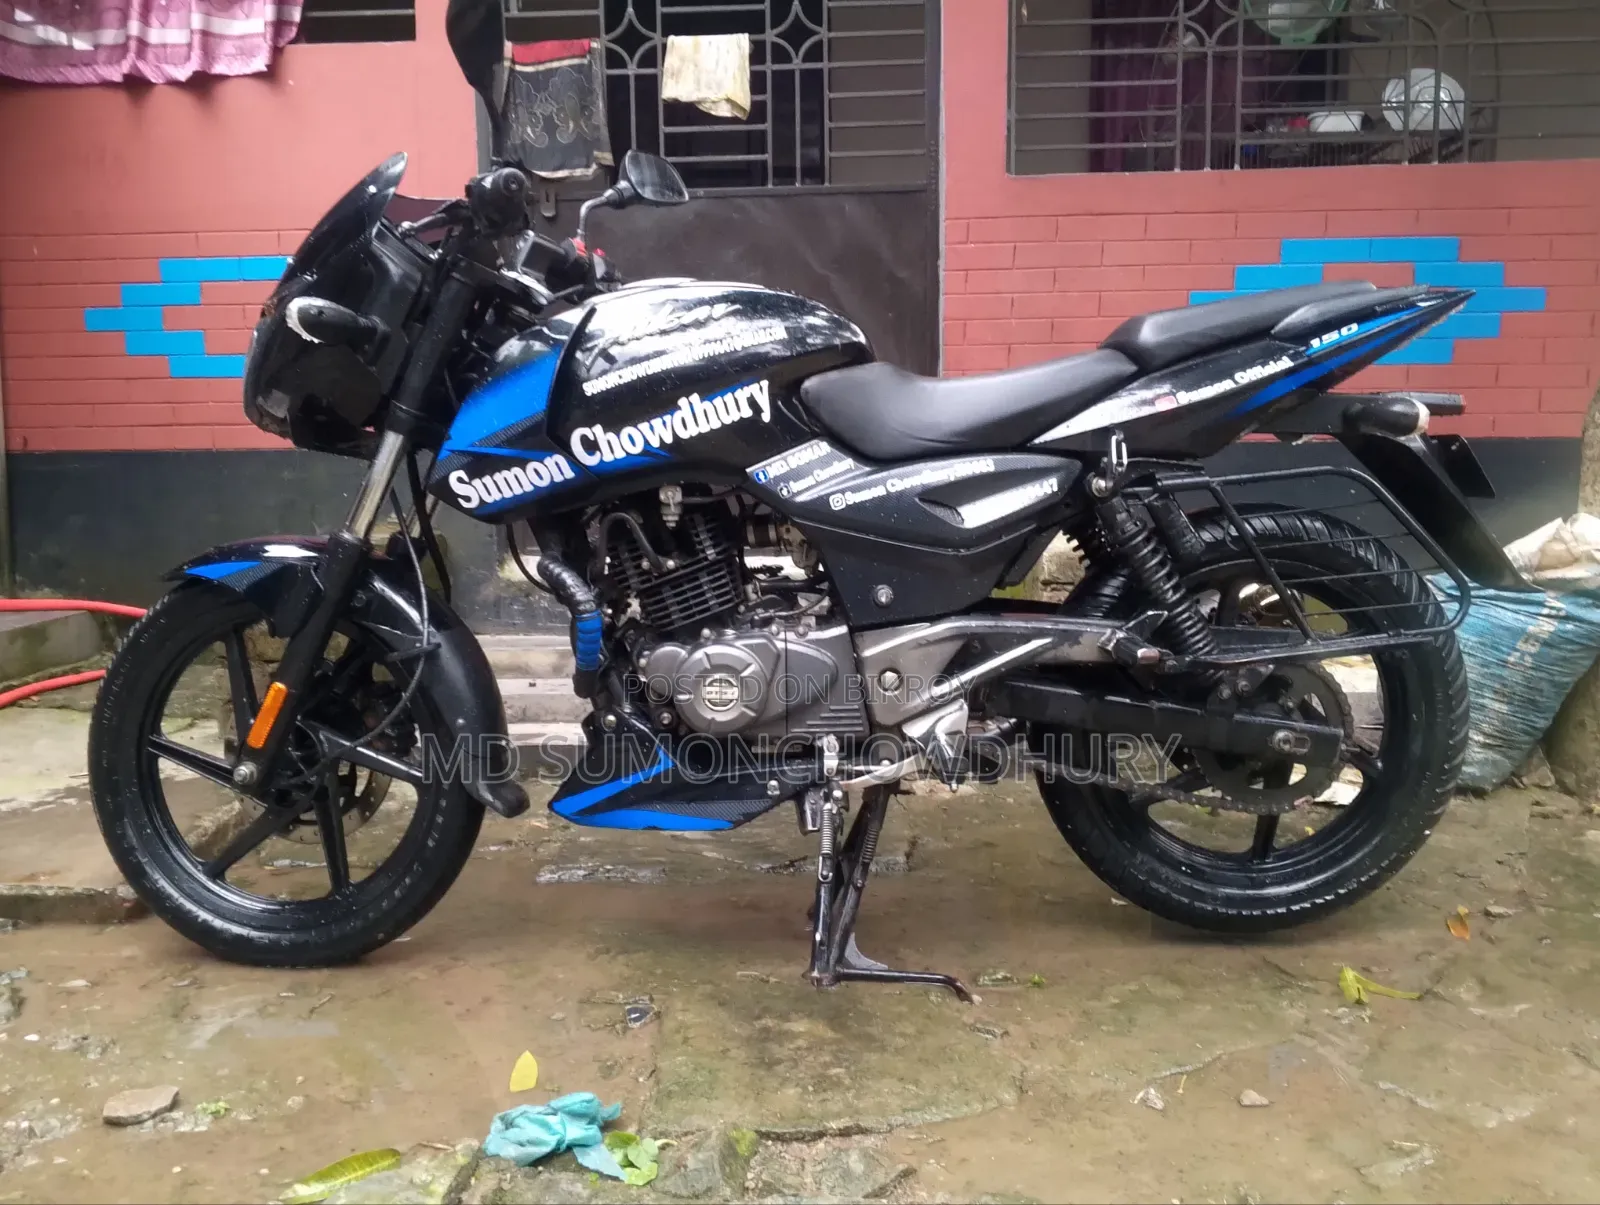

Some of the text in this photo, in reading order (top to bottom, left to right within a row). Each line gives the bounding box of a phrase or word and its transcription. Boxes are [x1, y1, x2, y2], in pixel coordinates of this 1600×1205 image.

[1310, 322, 1359, 349] 150
[448, 379, 770, 508] Sumon Chowdhury
